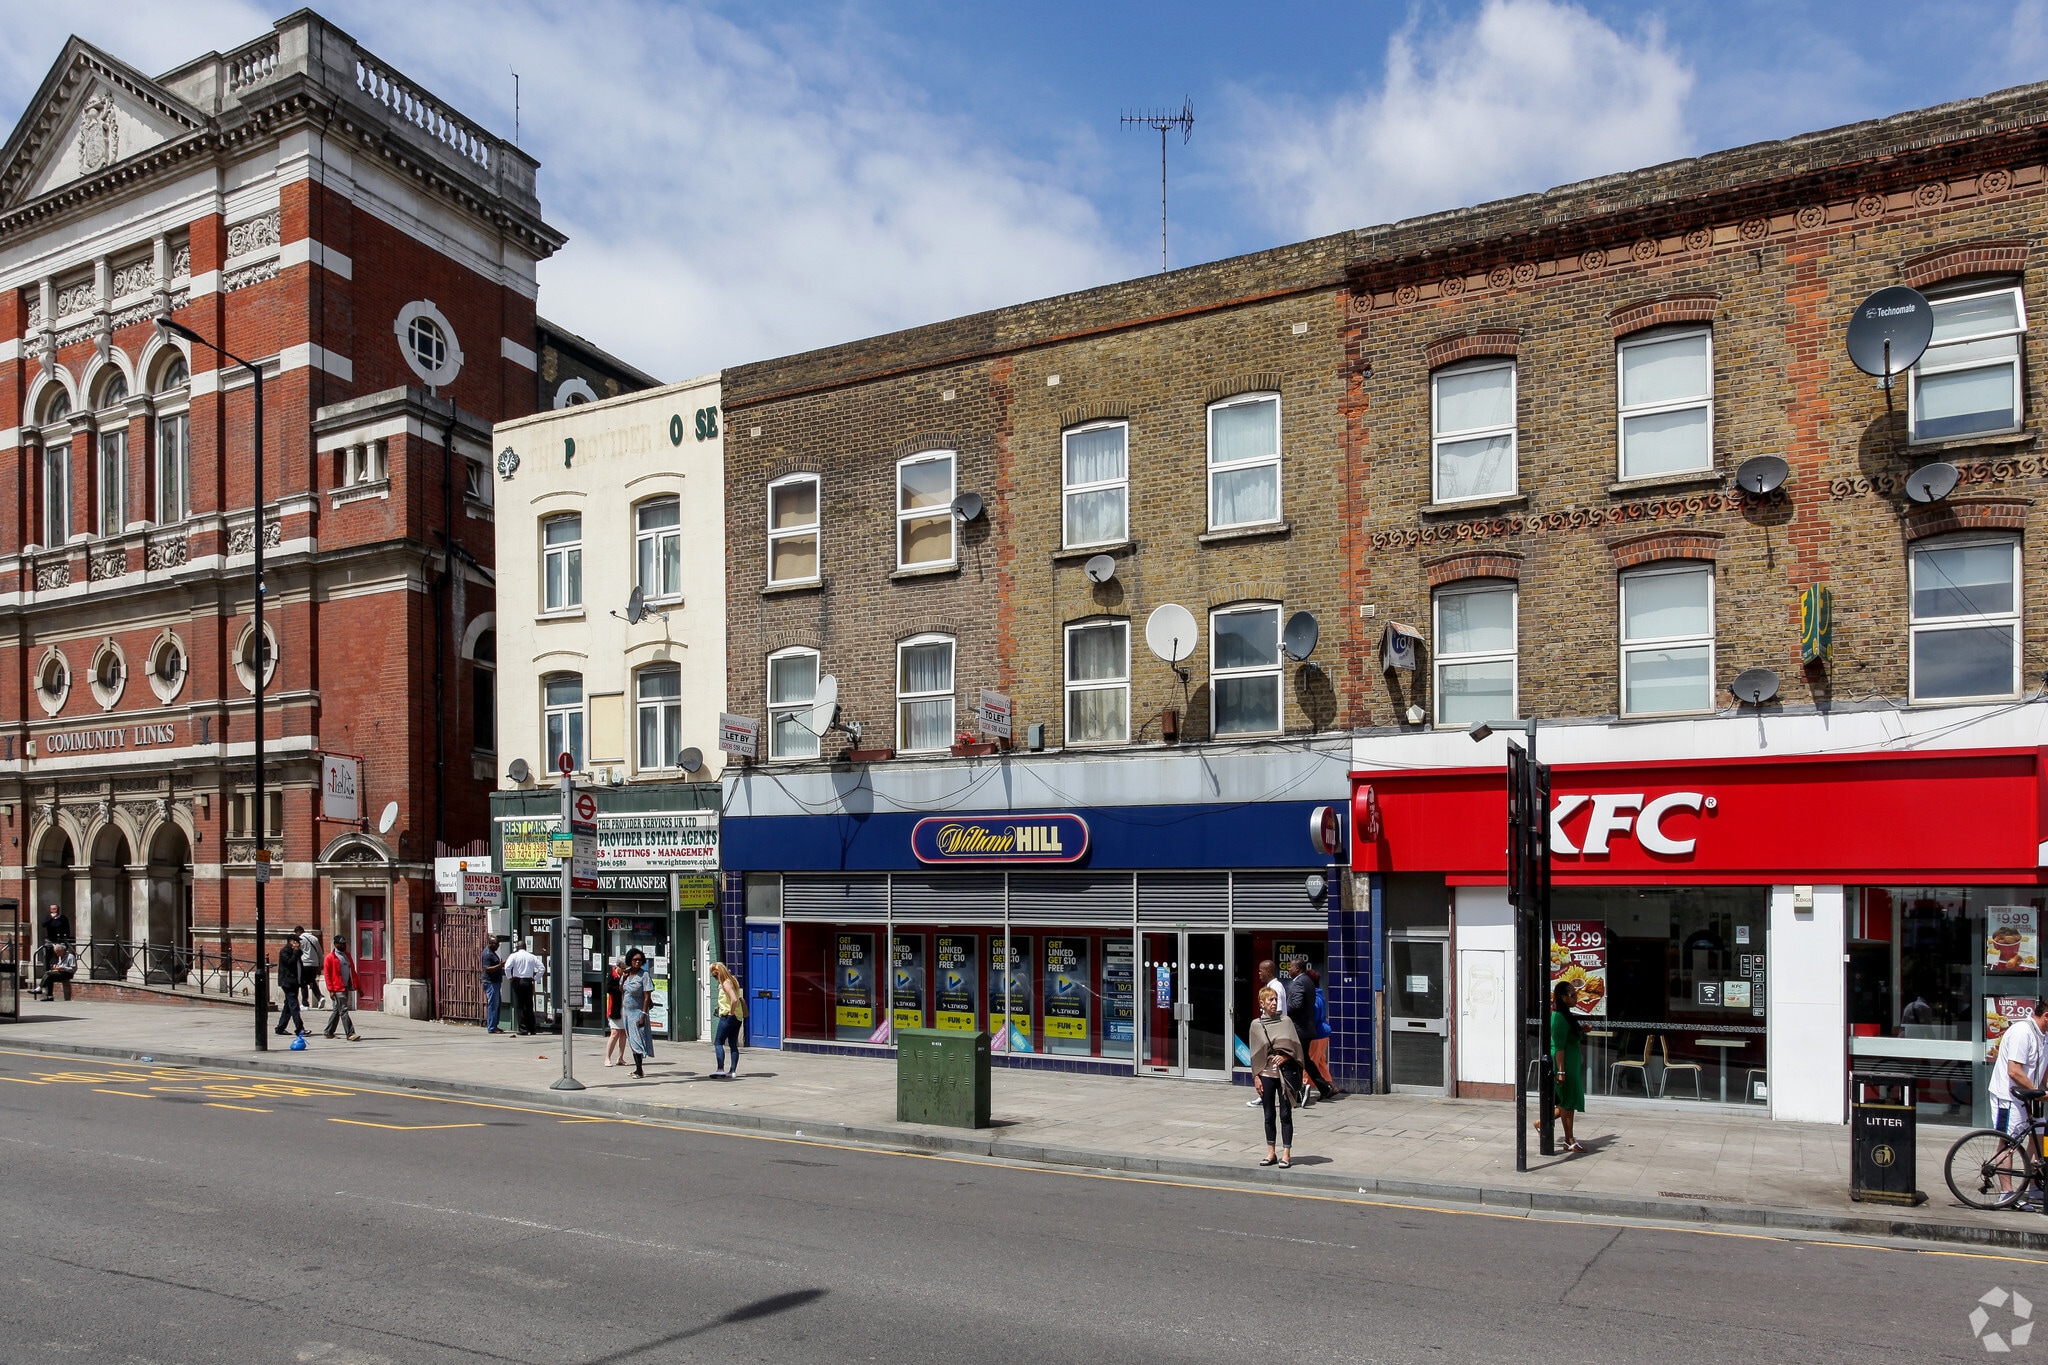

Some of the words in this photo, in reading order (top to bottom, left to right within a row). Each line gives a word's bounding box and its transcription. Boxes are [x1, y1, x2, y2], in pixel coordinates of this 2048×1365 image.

[1878, 304, 1916, 317] Technomate
[985, 711, 992, 720] TO
[994, 714, 1004, 722] LET
[46, 729, 126, 753] COMMUNITY
[134, 724, 175, 746] LINKS
[726, 732, 739, 740] LET
[505, 820, 524, 835] BEST
[527, 820, 547, 835] CARS
[598, 820, 610, 830] THE
[612, 819, 641, 829] PROVIDER
[643, 818, 672, 828] SERVICES
[674, 818, 684, 828] UK
[685, 817, 697, 828] LTD
[1550, 792, 1704, 854] KFC
[599, 832, 642, 846] PROVIDER
[645, 830, 678, 846] ESTATE
[681, 830, 717, 845] AGENTS
[937, 824, 1016, 854] William
[1017, 826, 1062, 851] HILL
[597, 850, 605, 858] ES
[613, 849, 650, 858] LETTINGS
[658, 848, 714, 856] MANAGEMENT
[465, 876, 500, 884] MINICAB
[597, 877, 617, 888] NEY
[621, 876, 667, 888] TRANSFER
[608, 918, 632, 930] OPEN
[2002, 914, 2029, 924] 9.99
[1567, 932, 1601, 946] 2.99
[1279, 945, 1295, 953] GET
[2006, 1006, 2033, 1017] 2.99
[1867, 1117, 1902, 1127] LITTER
